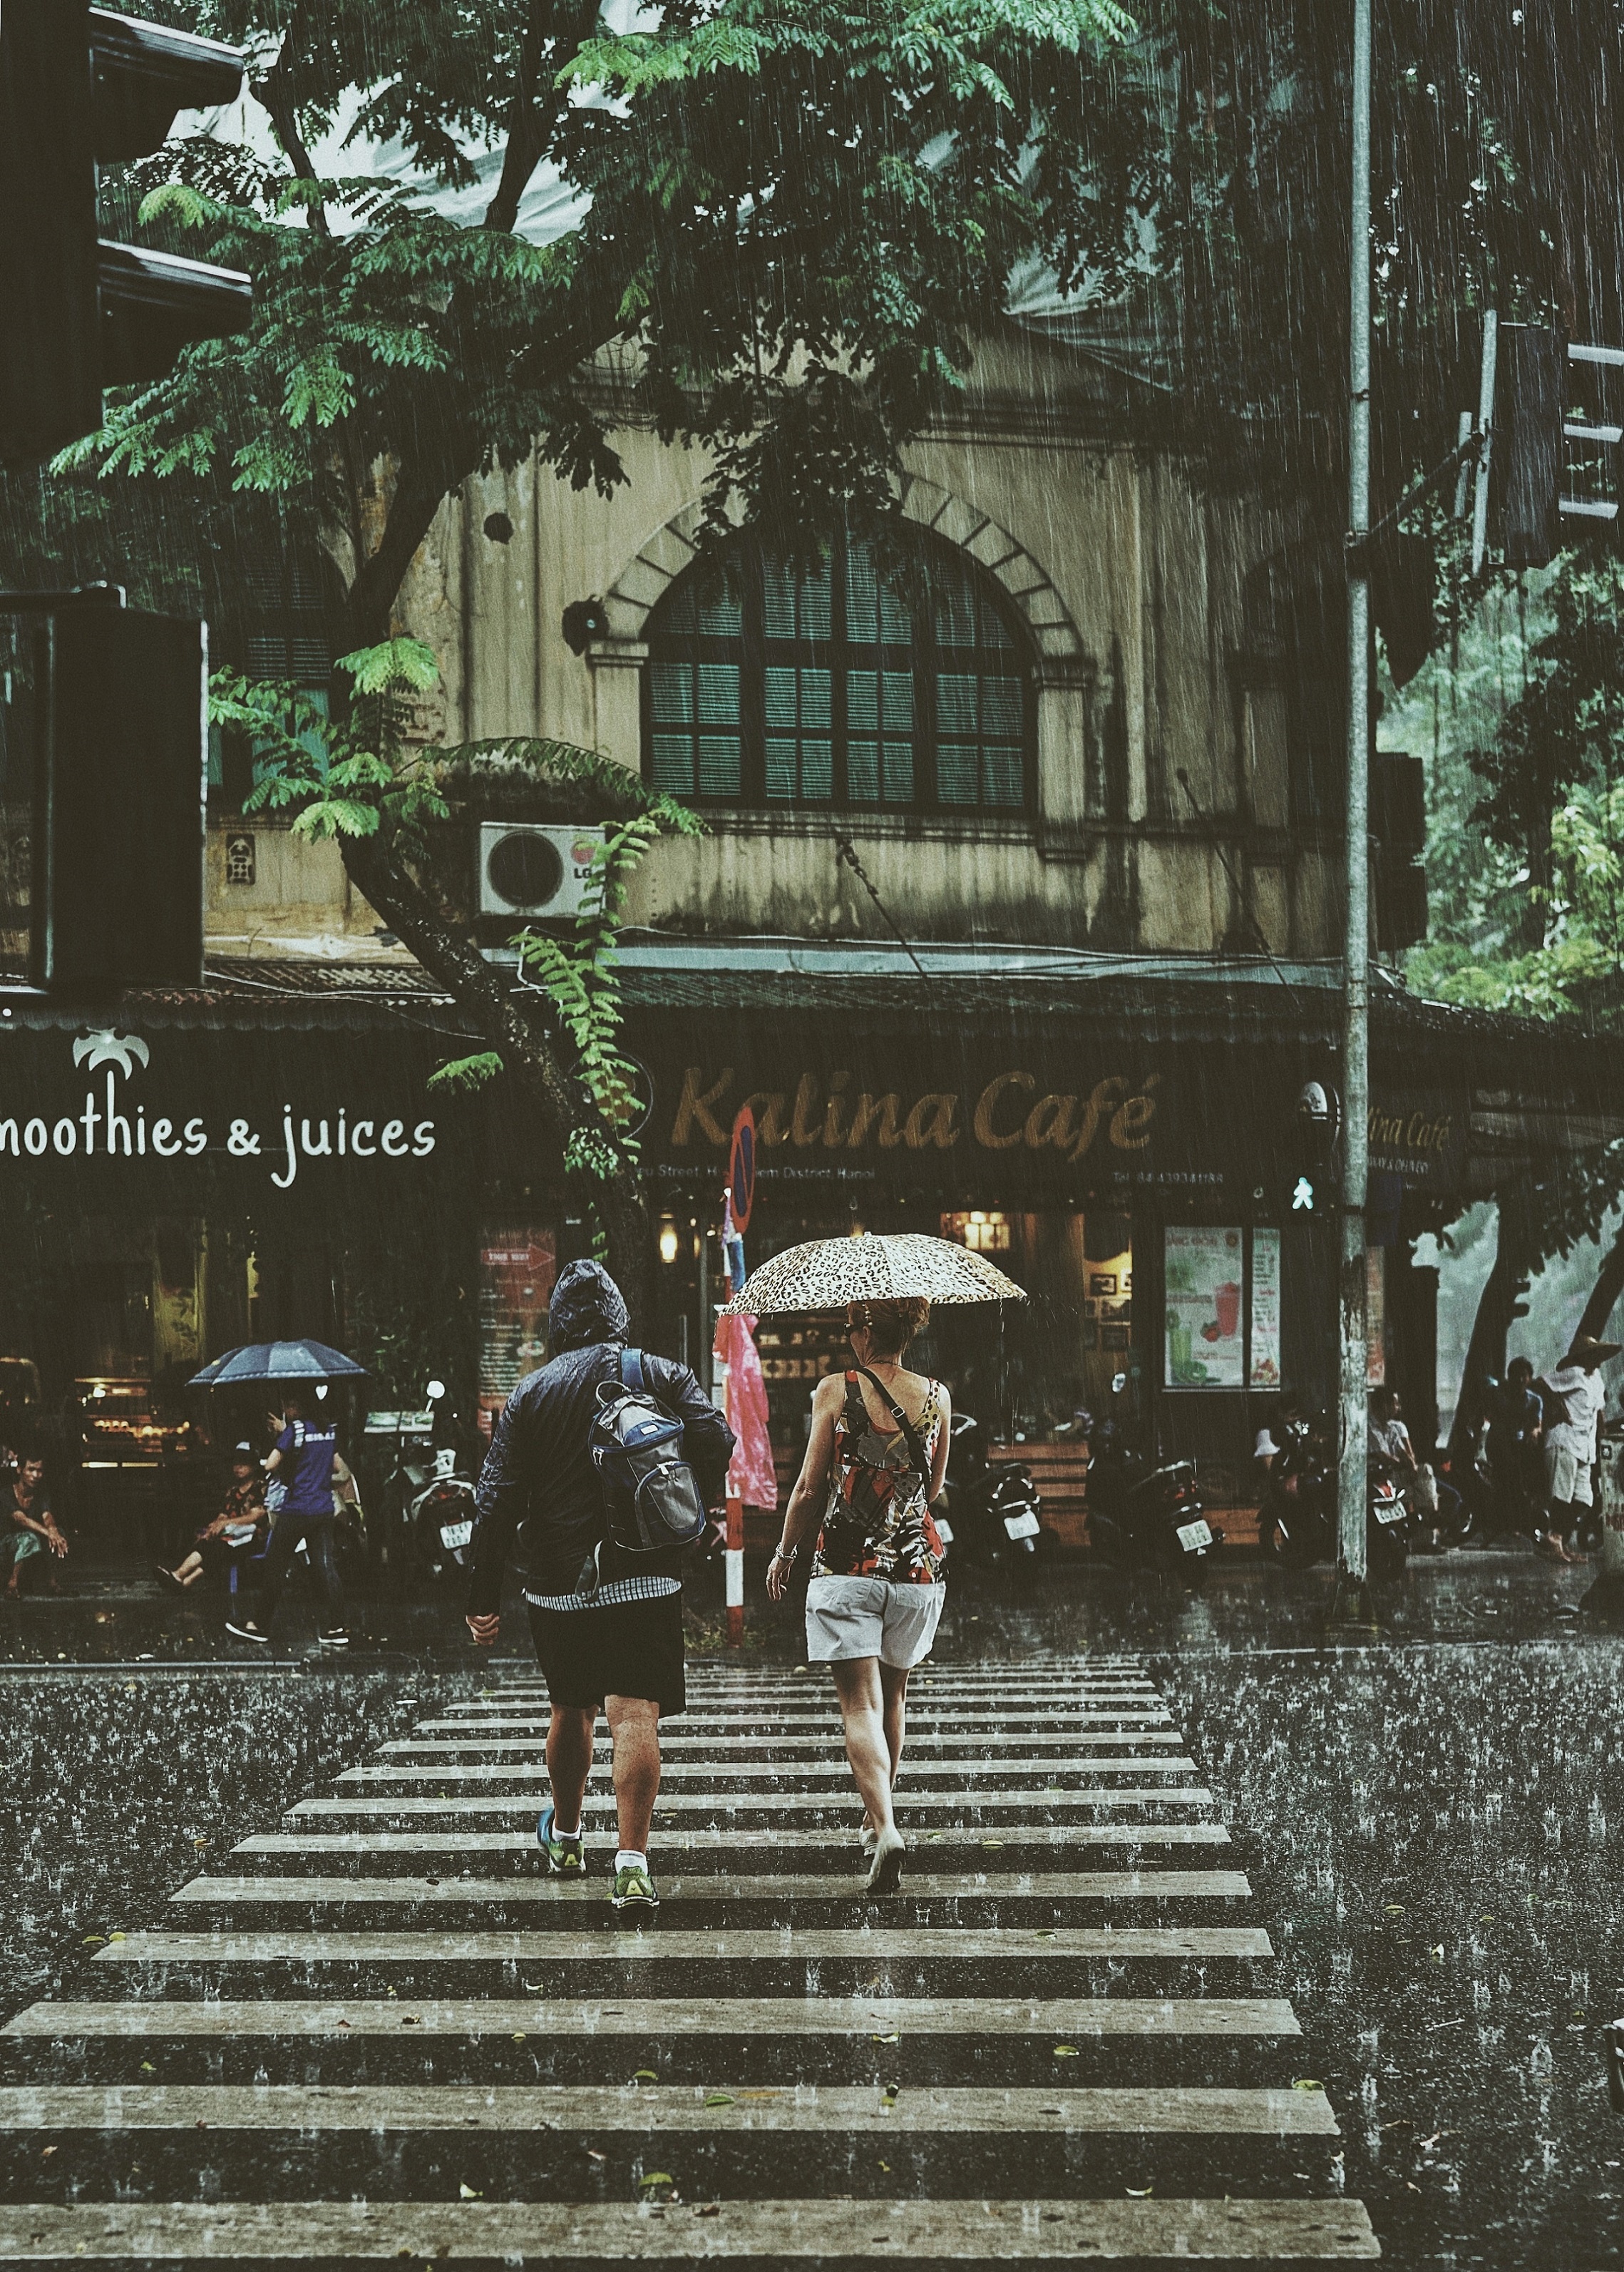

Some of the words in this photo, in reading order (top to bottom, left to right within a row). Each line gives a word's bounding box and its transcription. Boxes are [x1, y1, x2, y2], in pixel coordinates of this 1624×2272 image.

[574, 867, 592, 879] LG
[0, 1072, 207, 1156] moothies
[227, 1118, 261, 1155] &
[271, 1105, 436, 1187] juices
[672, 1068, 960, 1149] Kalina
[974, 1070, 1161, 1162] Café
